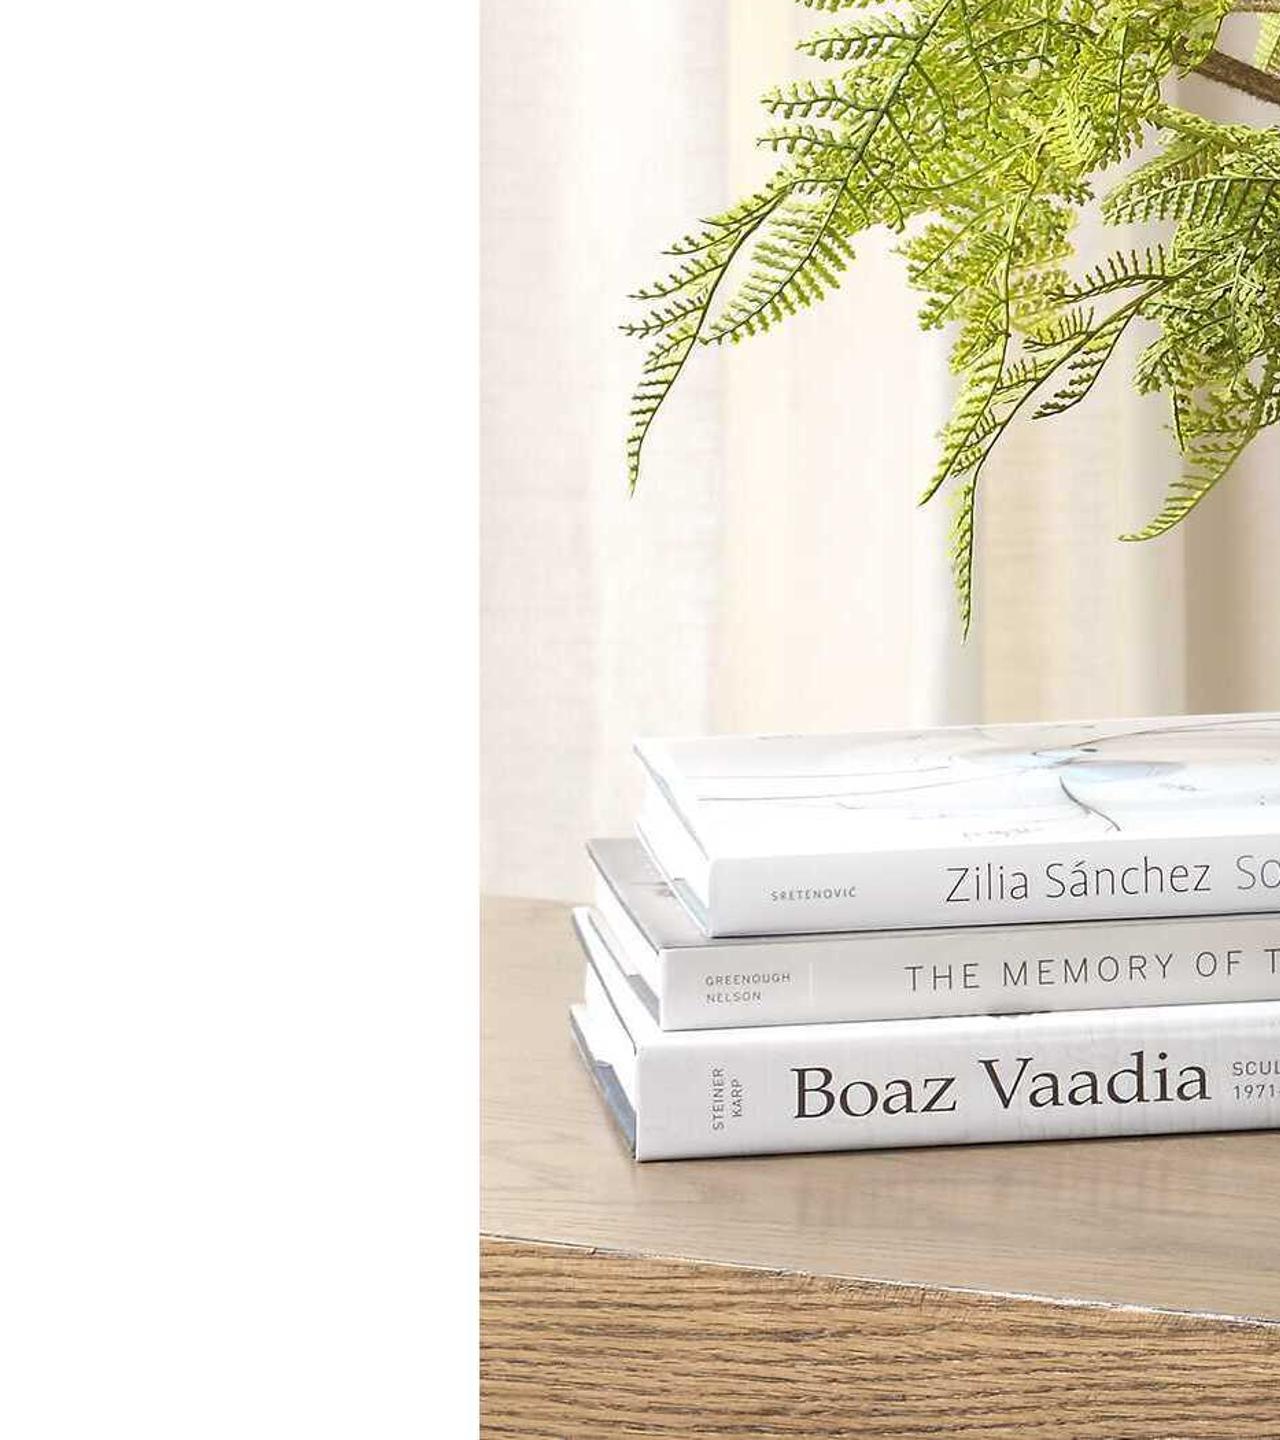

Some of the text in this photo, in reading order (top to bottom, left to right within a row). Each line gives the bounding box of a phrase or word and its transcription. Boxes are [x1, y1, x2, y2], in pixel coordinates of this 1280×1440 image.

[946, 863, 1028, 902] Zilia
[1045, 856, 1211, 898] Sánchez
[705, 973, 791, 986] GREENOUGH
[904, 963, 980, 991] THE
[1002, 953, 1173, 987] MEMORY
[1195, 951, 1243, 978] OF
[706, 991, 762, 1003] NELSON
[712, 1067, 725, 1131] STEINER
[731, 1078, 743, 1117] KARP
[790, 1051, 1212, 1120] Boaz Vaadia
